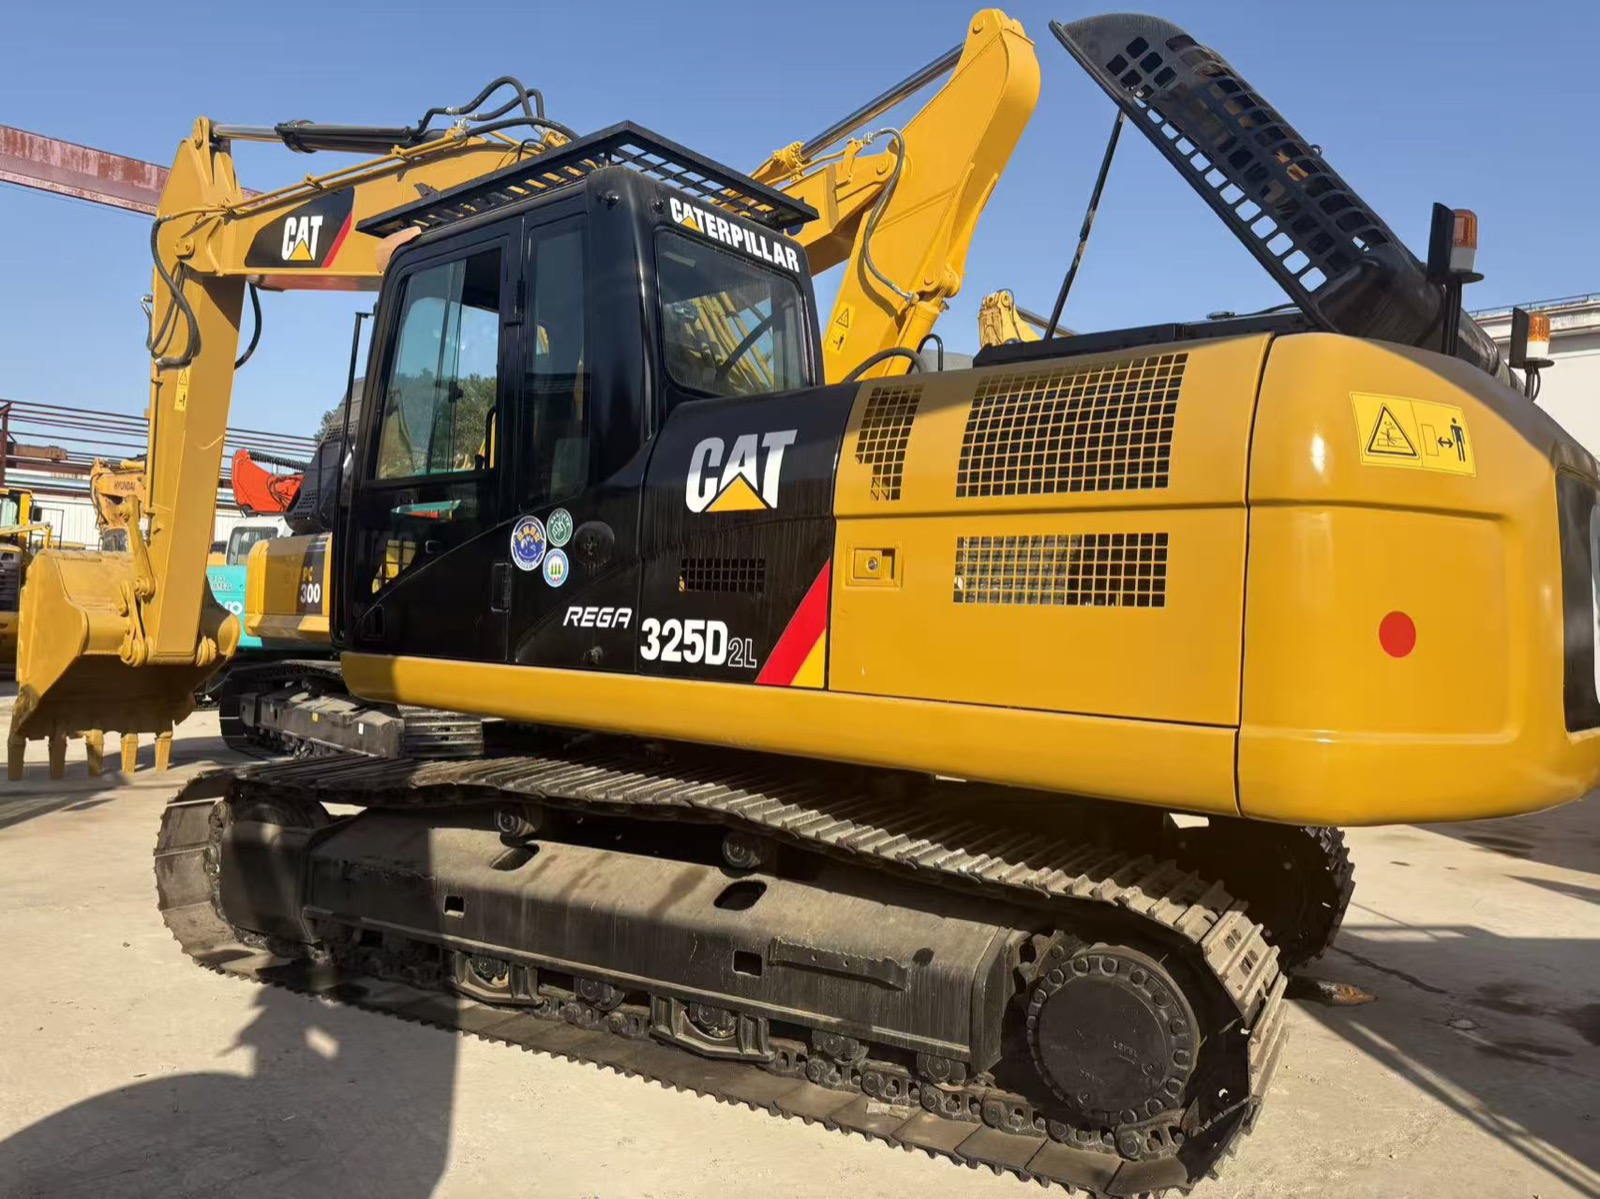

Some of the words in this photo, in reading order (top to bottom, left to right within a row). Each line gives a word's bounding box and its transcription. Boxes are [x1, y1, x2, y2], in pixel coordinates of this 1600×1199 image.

[281, 214, 324, 261] CAT
[669, 197, 801, 274] CATERPILLAR
[113, 480, 136, 491] HYUNDAI
[685, 429, 798, 513] CAT
[300, 583, 321, 604] 300
[563, 606, 633, 629] REGA
